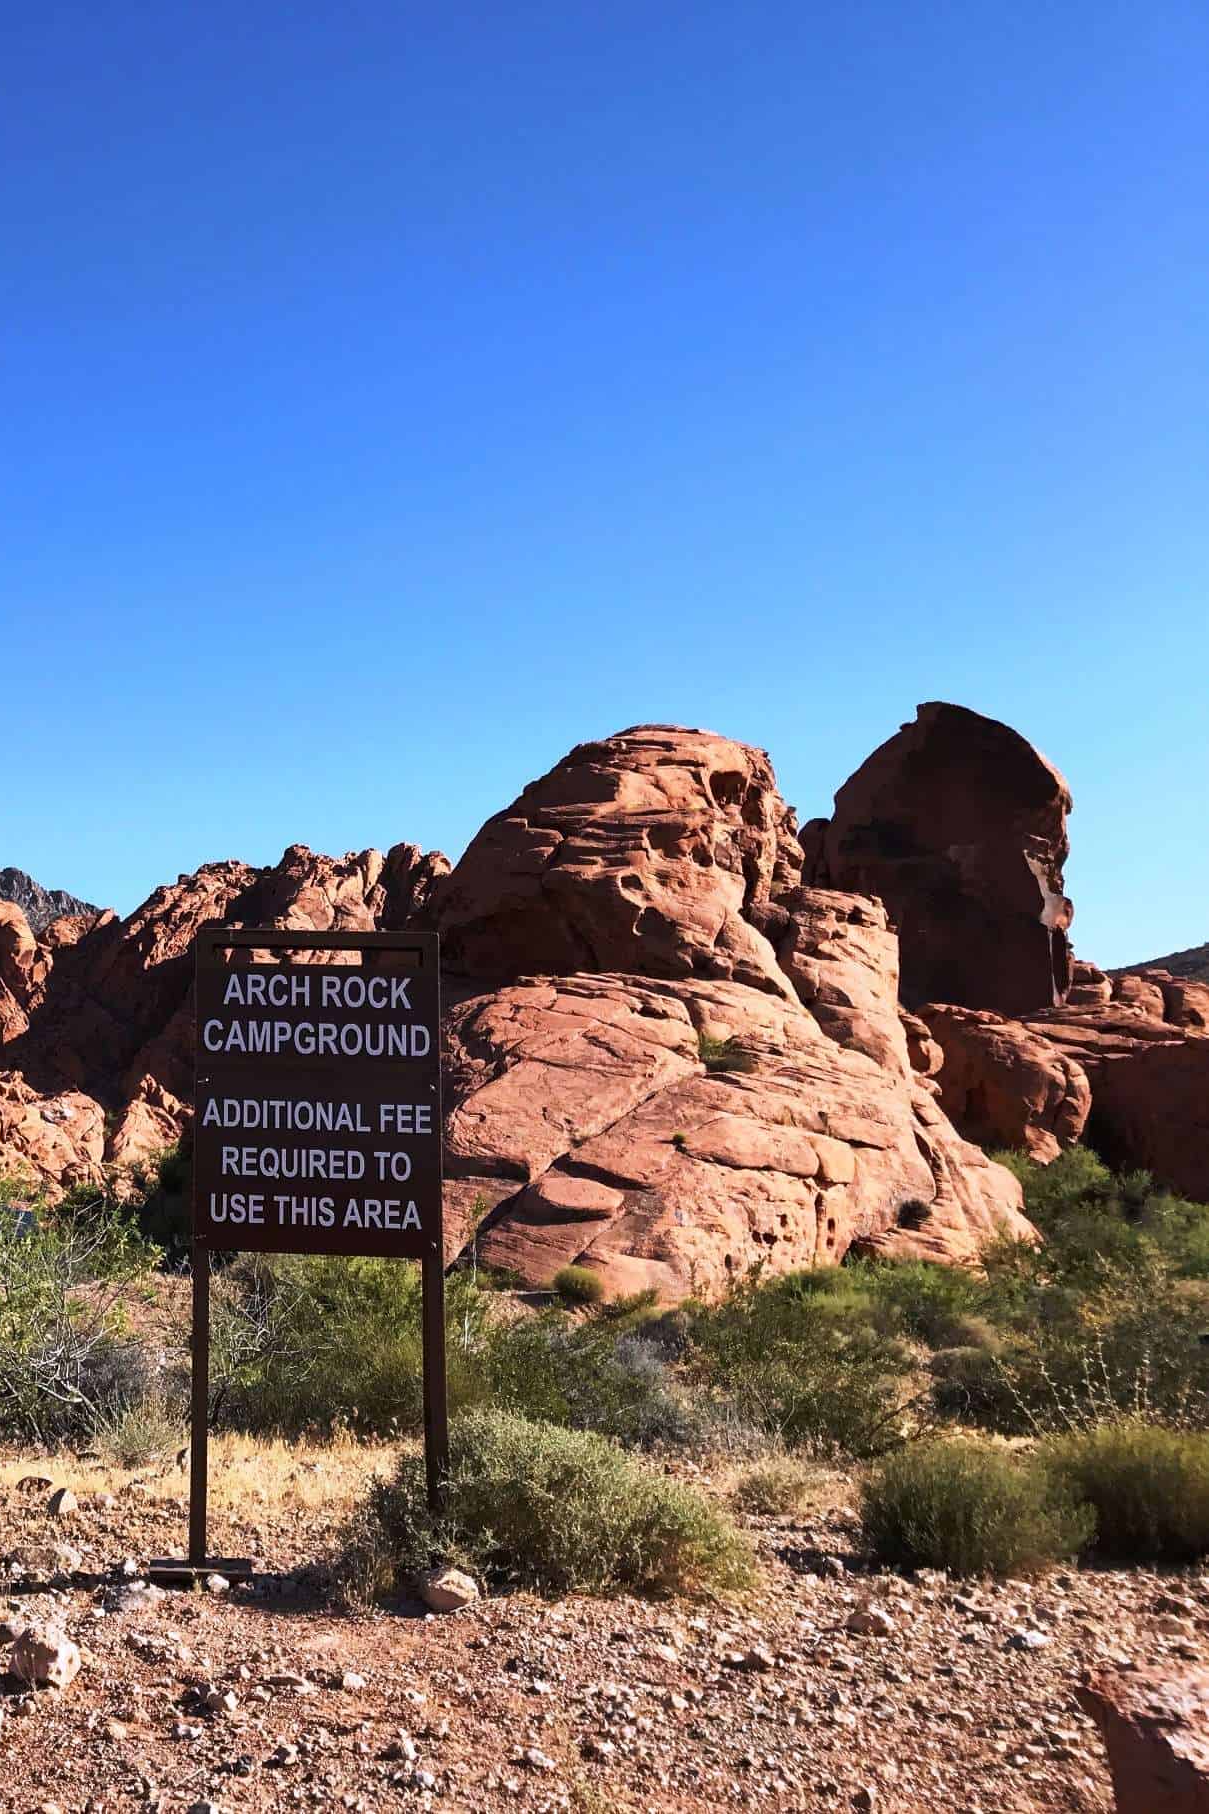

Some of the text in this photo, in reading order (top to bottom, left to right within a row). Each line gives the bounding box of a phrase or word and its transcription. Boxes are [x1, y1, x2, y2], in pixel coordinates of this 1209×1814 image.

[223, 974, 412, 1009] ARCH ROCK
[204, 1019, 430, 1056] CAMPGROUND
[202, 1099, 432, 1134] ADDITIONAL FEE
[222, 1146, 411, 1181] REQUIRED TO
[210, 1193, 422, 1230] USE THIS AREA
